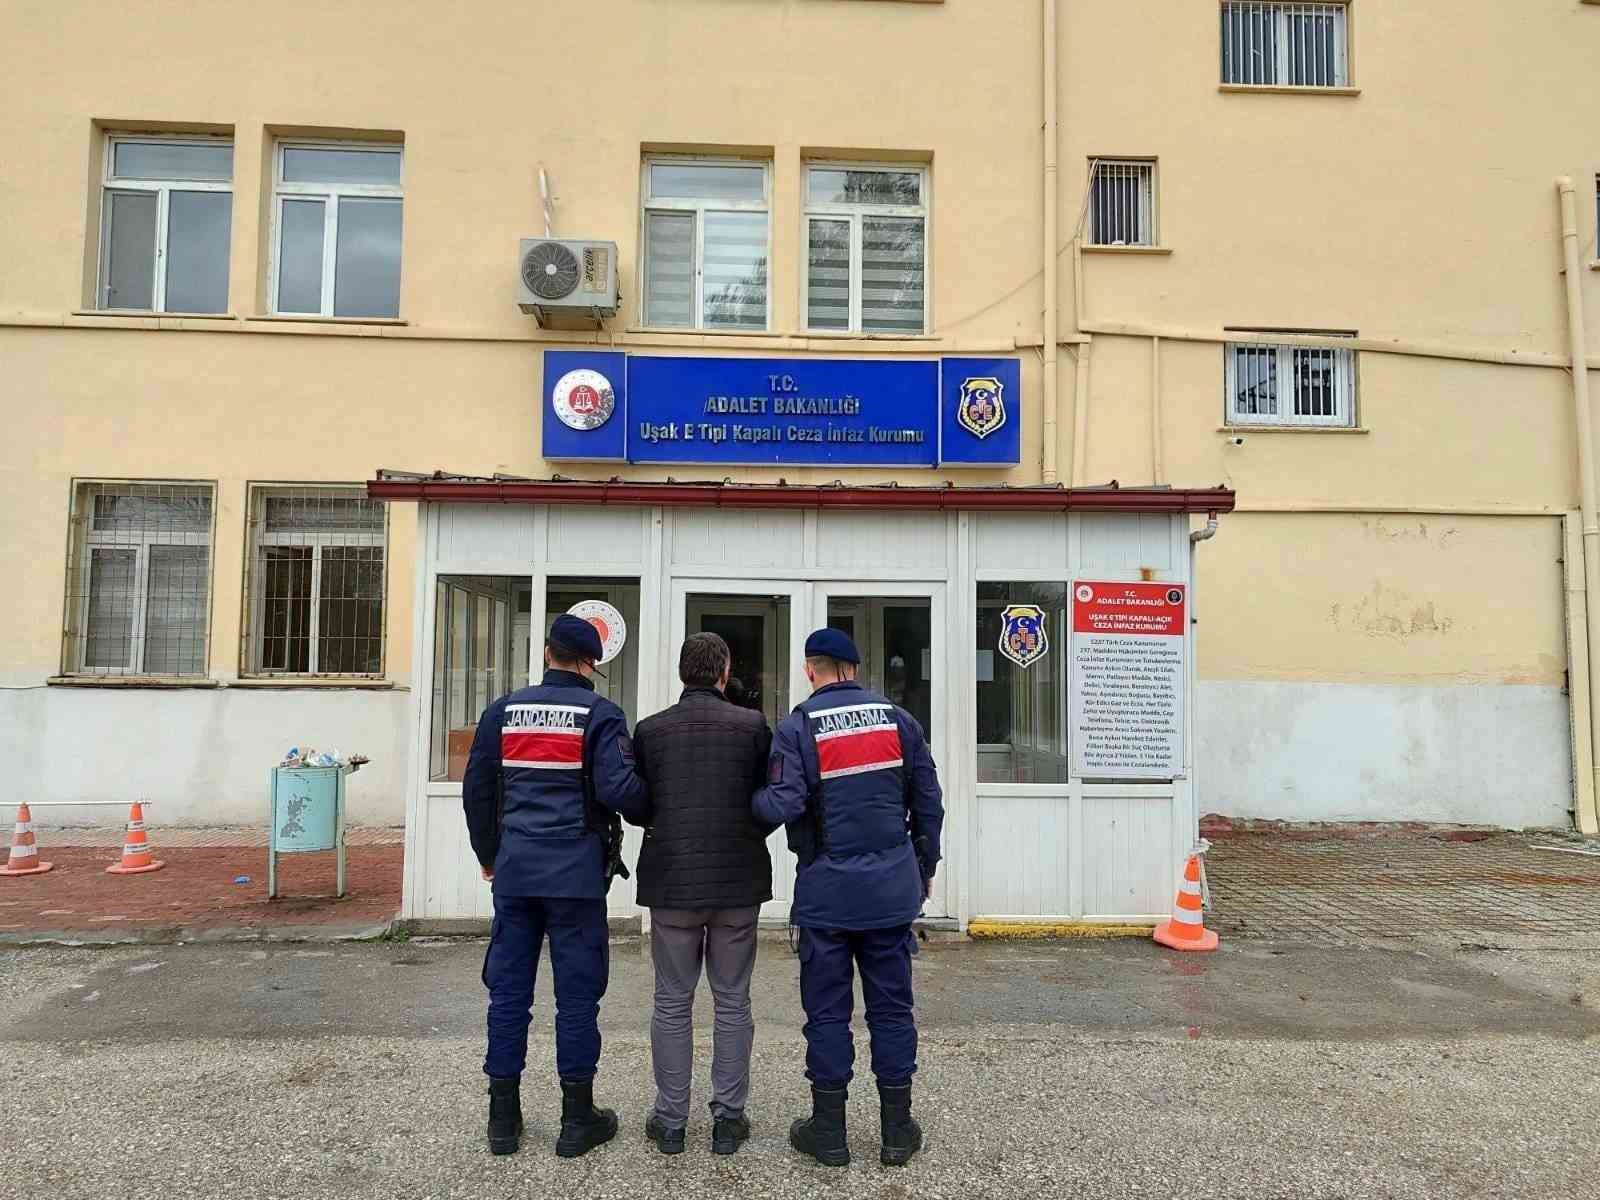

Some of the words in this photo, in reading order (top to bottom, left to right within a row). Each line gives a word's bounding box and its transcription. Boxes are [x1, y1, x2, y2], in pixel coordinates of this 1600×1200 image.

[768, 375, 798, 392] T.C.
[706, 397, 768, 414] ADALET
[774, 395, 860, 415] BAKANLIĞI
[640, 422, 679, 443] Uşak
[684, 423, 694, 439] E
[698, 423, 727, 443] Tipi
[733, 424, 781, 443] Kapalı
[787, 425, 823, 442] Ceza
[868, 426, 925, 443] Kurumu
[1126, 598, 1165, 607] BAKANLIĞI
[507, 709, 575, 728] JANDARMA
[818, 709, 890, 733] JANDARMA
